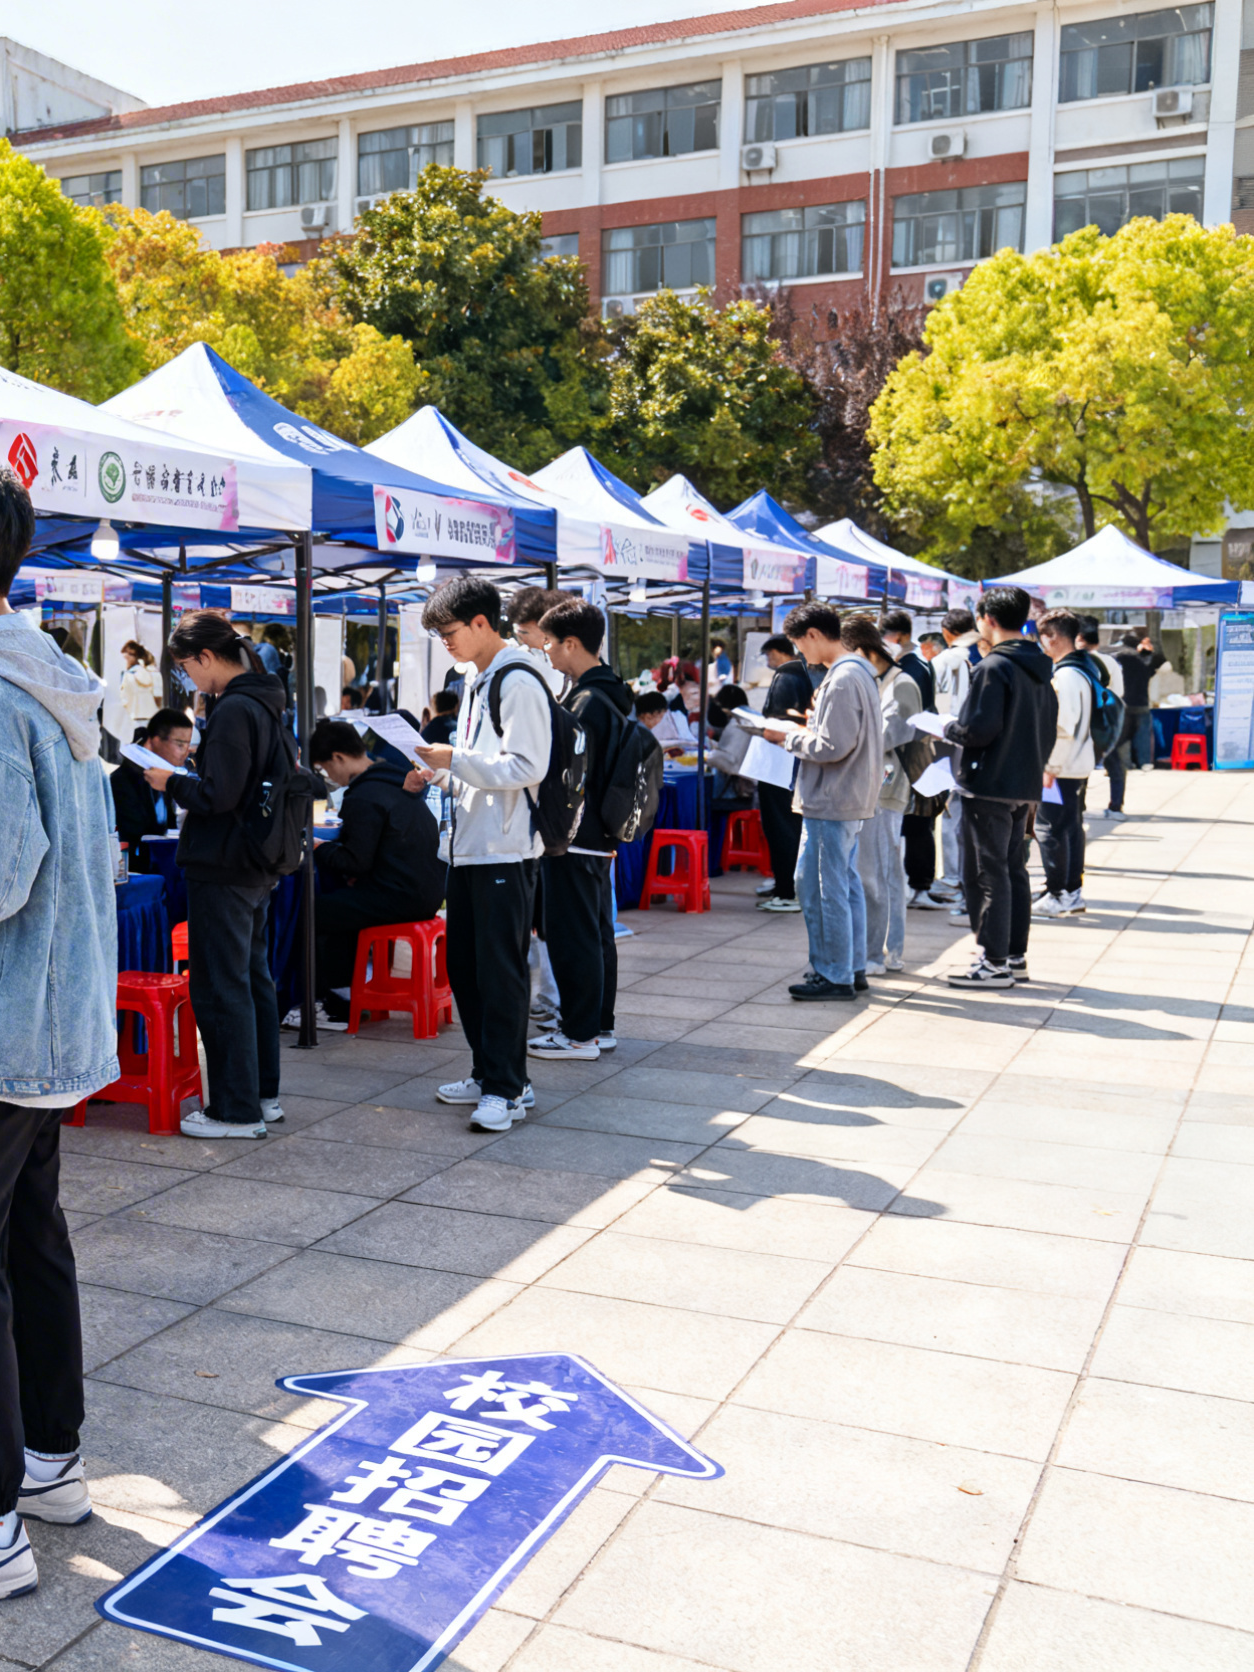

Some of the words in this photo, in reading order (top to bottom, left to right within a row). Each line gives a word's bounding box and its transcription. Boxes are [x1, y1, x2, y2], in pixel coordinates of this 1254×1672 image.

[209, 1370, 579, 1647] 校园招聘会
